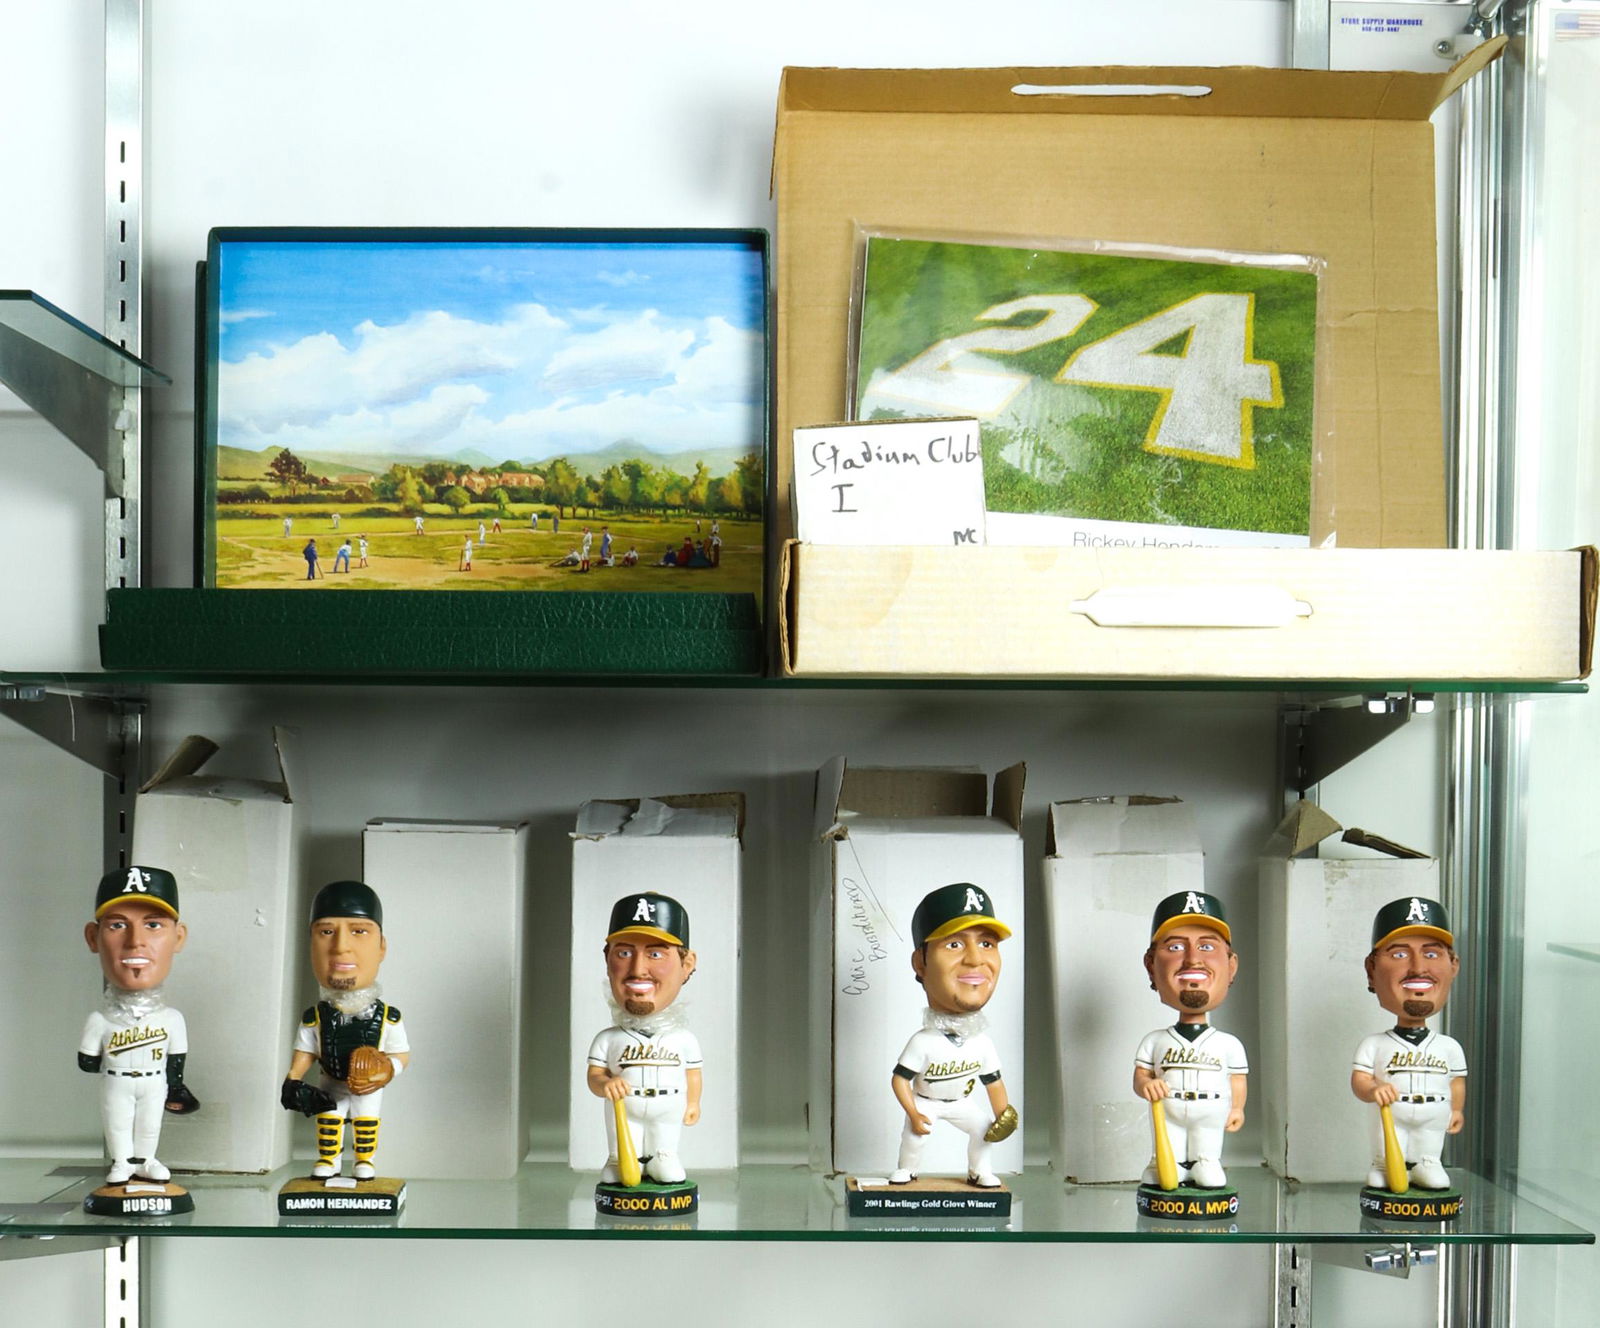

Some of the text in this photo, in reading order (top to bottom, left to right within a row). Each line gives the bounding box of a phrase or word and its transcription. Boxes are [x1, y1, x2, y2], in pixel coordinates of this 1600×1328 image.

[1386, 18, 1423, 26] WAREHOUSE
[865, 292, 1285, 470] 24
[810, 434, 979, 477] Stadium Club
[109, 1025, 168, 1049] Athletics
[151, 1048, 163, 1061] 15
[619, 1045, 680, 1062] Athletics
[1161, 1048, 1221, 1066] Athletics
[1386, 1051, 1448, 1070] Athletics
[925, 1060, 983, 1077] Athletics
[964, 1078, 976, 1095] 3
[122, 1198, 173, 1212] HUDSON
[286, 1197, 392, 1210] RAMON HERNANDEZ
[614, 1195, 693, 1211] 2000 AL MVP
[864, 1199, 997, 1209] 2001 Rawlings Gold Glove Winner
[1151, 1199, 1229, 1215] 2000 AL MVP
[1383, 1202, 1459, 1216] 2000 AL MVP
